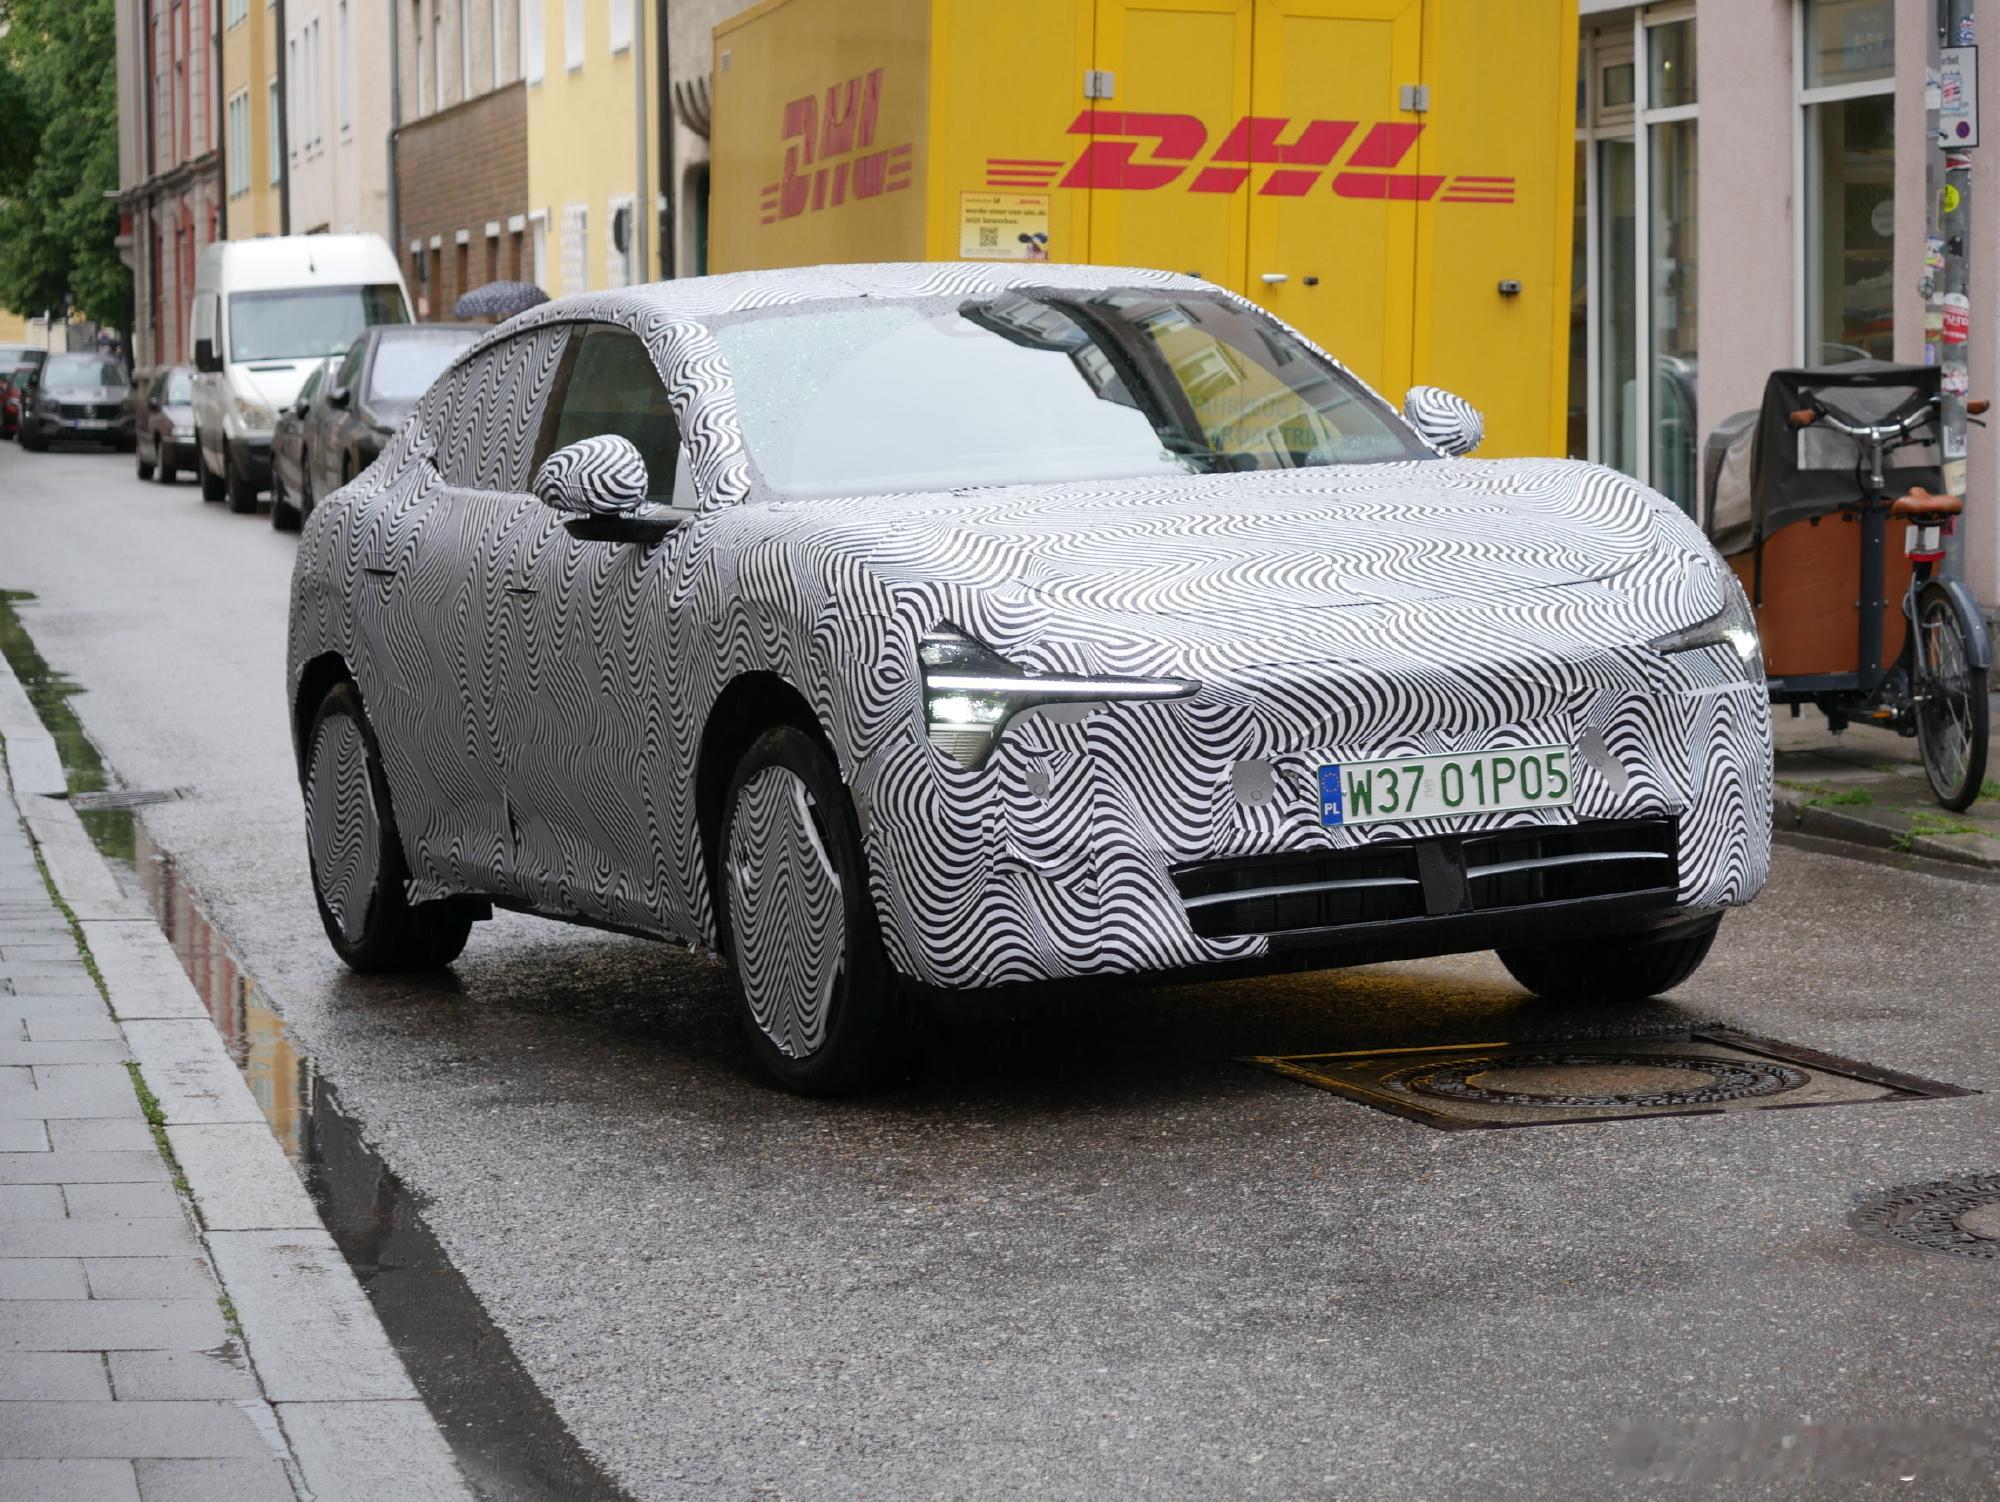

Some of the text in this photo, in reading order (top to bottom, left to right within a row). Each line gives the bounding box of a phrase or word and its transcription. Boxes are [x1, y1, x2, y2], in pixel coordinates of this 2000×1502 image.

[778, 67, 889, 221] DHL
[1057, 109, 1448, 202] DHL
[1324, 803, 1341, 816] PL
[1347, 764, 1425, 817] W37
[1440, 752, 1568, 808] 01P05
